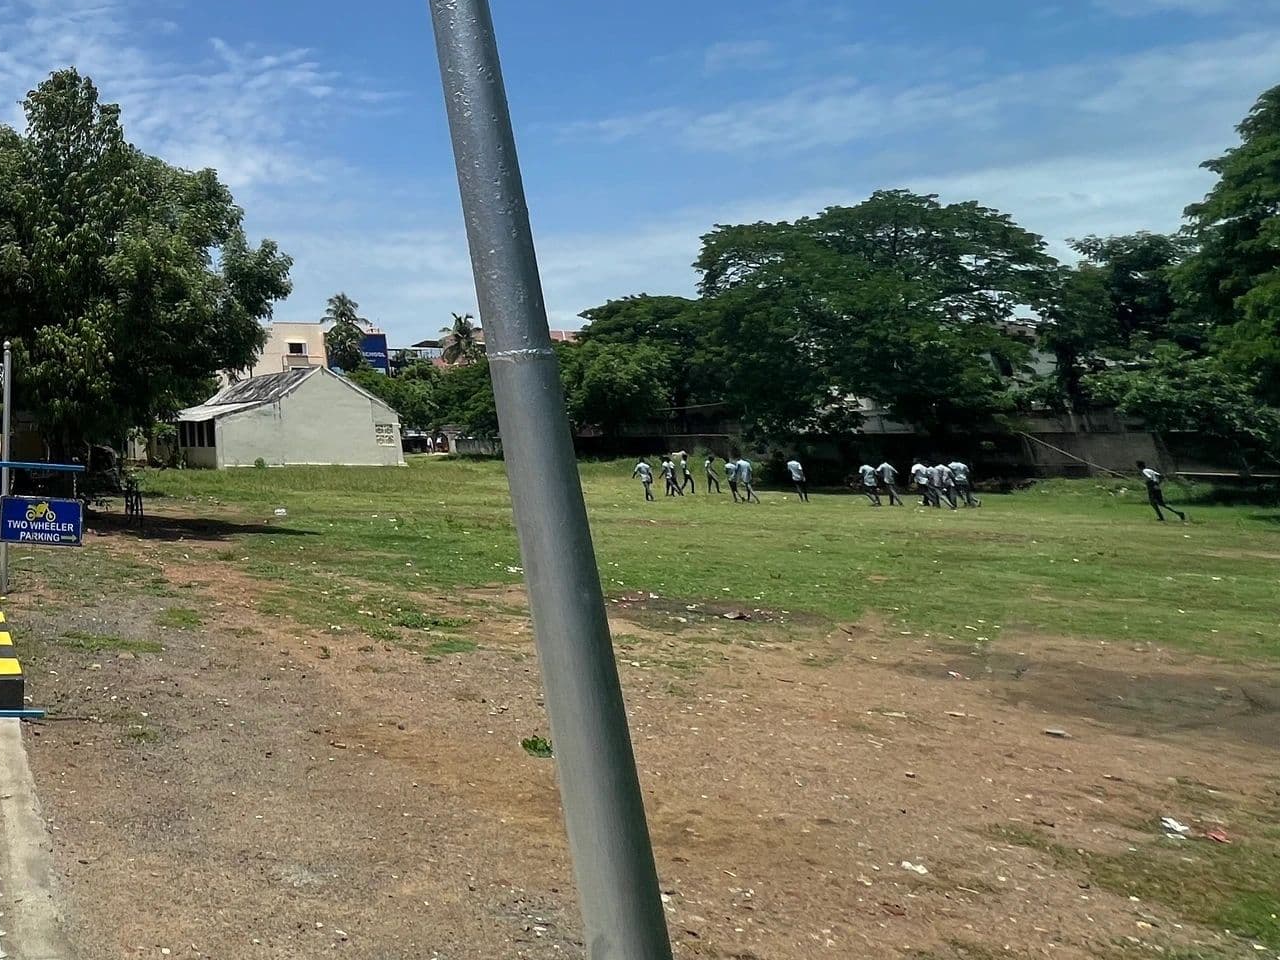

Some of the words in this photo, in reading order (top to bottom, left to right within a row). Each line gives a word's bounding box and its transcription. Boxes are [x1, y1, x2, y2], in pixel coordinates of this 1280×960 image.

[7, 520, 28, 529] TWO
[29, 522, 74, 532] WHEELER
[20, 531, 60, 542] PARKING
